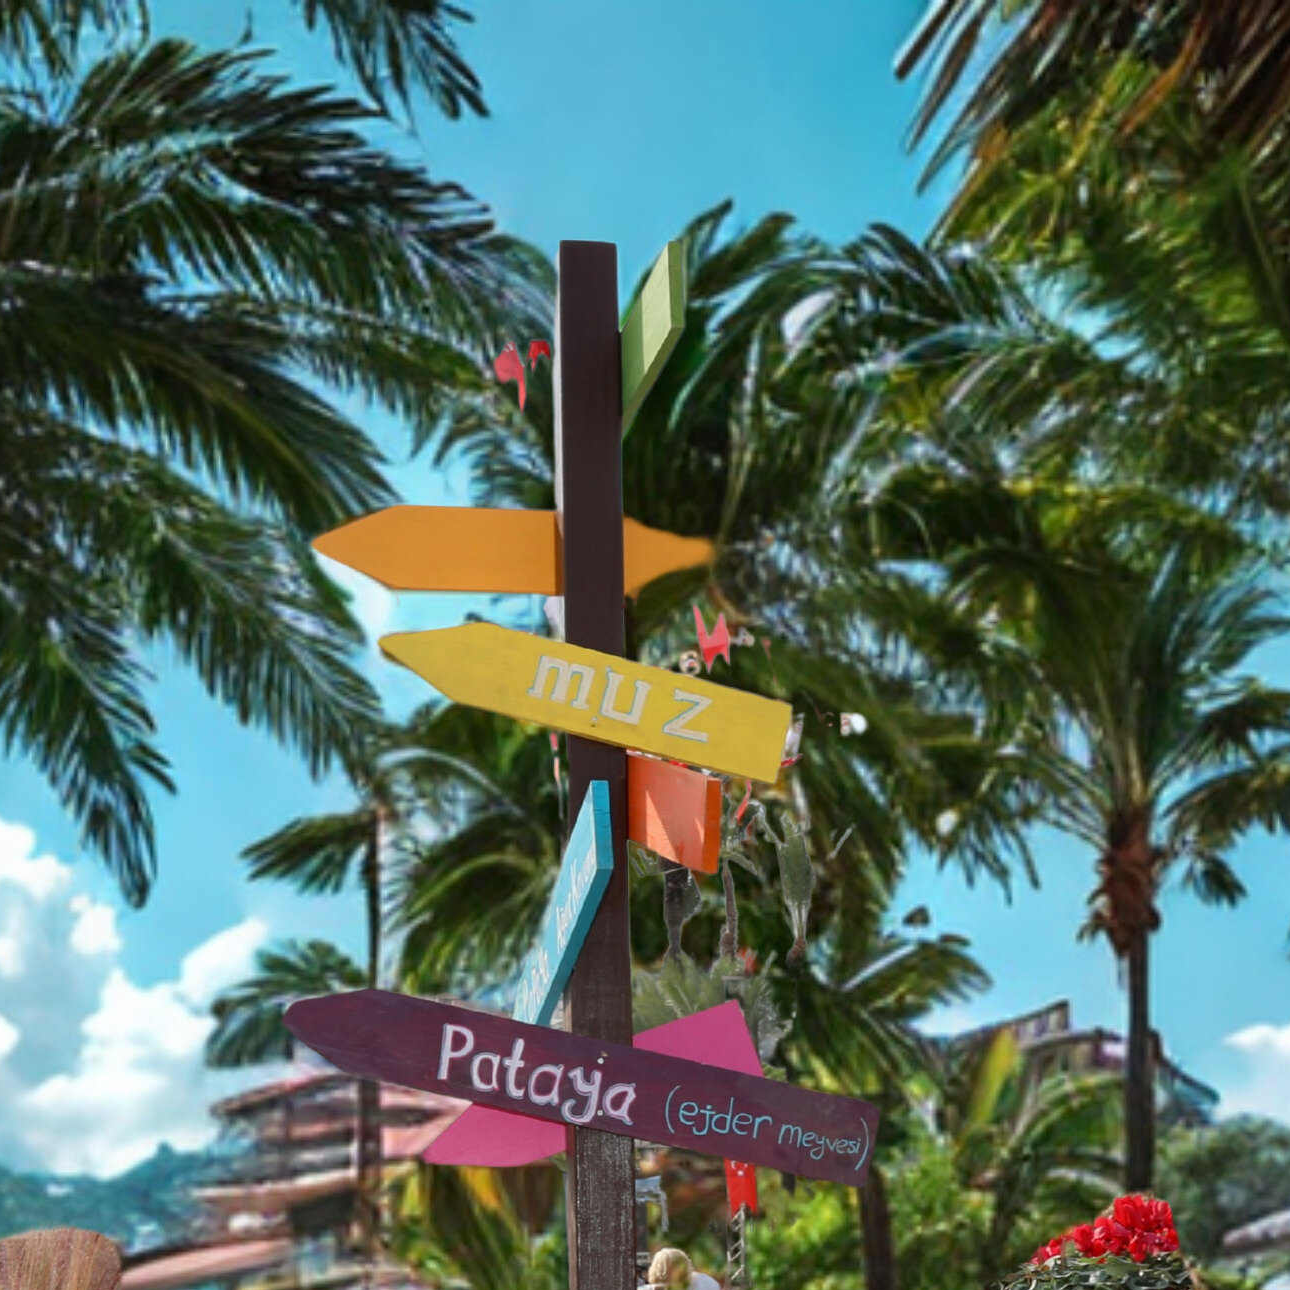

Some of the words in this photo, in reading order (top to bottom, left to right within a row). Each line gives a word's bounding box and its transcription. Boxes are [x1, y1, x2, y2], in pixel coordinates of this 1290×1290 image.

[527, 655, 713, 744] muz
[437, 1022, 637, 1126] Pataya
[665, 1085, 773, 1138] (ejder
[778, 1117, 869, 1171] meyvesi)
